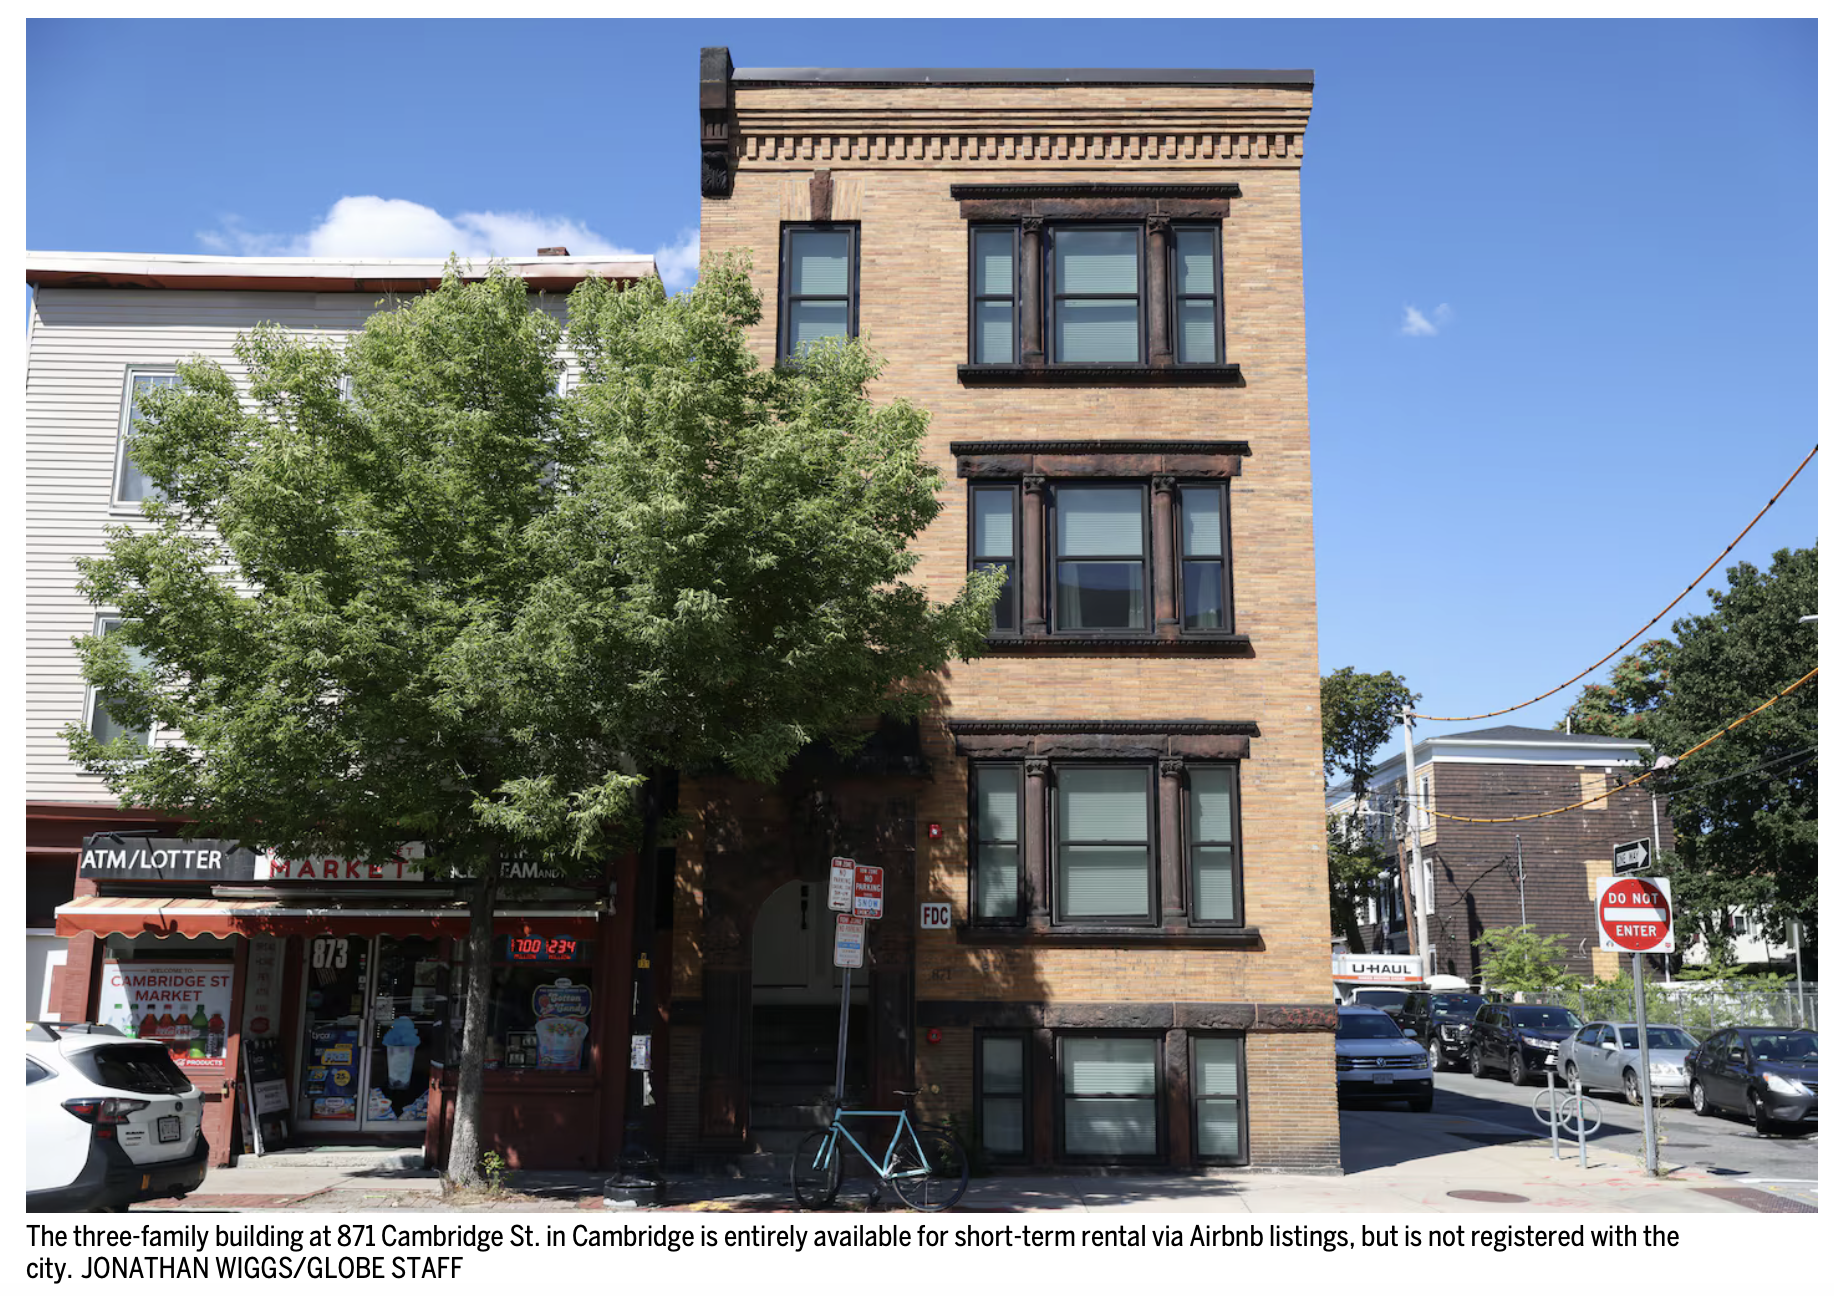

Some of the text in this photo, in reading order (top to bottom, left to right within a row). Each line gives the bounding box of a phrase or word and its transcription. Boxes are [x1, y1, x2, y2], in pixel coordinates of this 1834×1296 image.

[81, 849, 221, 870] ATM/LOTTER
[1616, 852, 1626, 865] ONE
[270, 859, 409, 879] MARKET
[864, 875, 873, 883] NO
[856, 882, 882, 892] PARKING
[857, 898, 879, 908] SNOW
[1608, 892, 1659, 904] DO NOT
[923, 906, 948, 925] FDC
[1616, 924, 1657, 937] ENTER
[312, 939, 348, 969] 873
[931, 968, 951, 981] 871
[1352, 963, 1411, 975] U-HAUL
[110, 975, 230, 988] CAMBRIDGE ST
[135, 990, 203, 1002] MARKET
[185, 1059, 223, 1067] PRODUCTS
